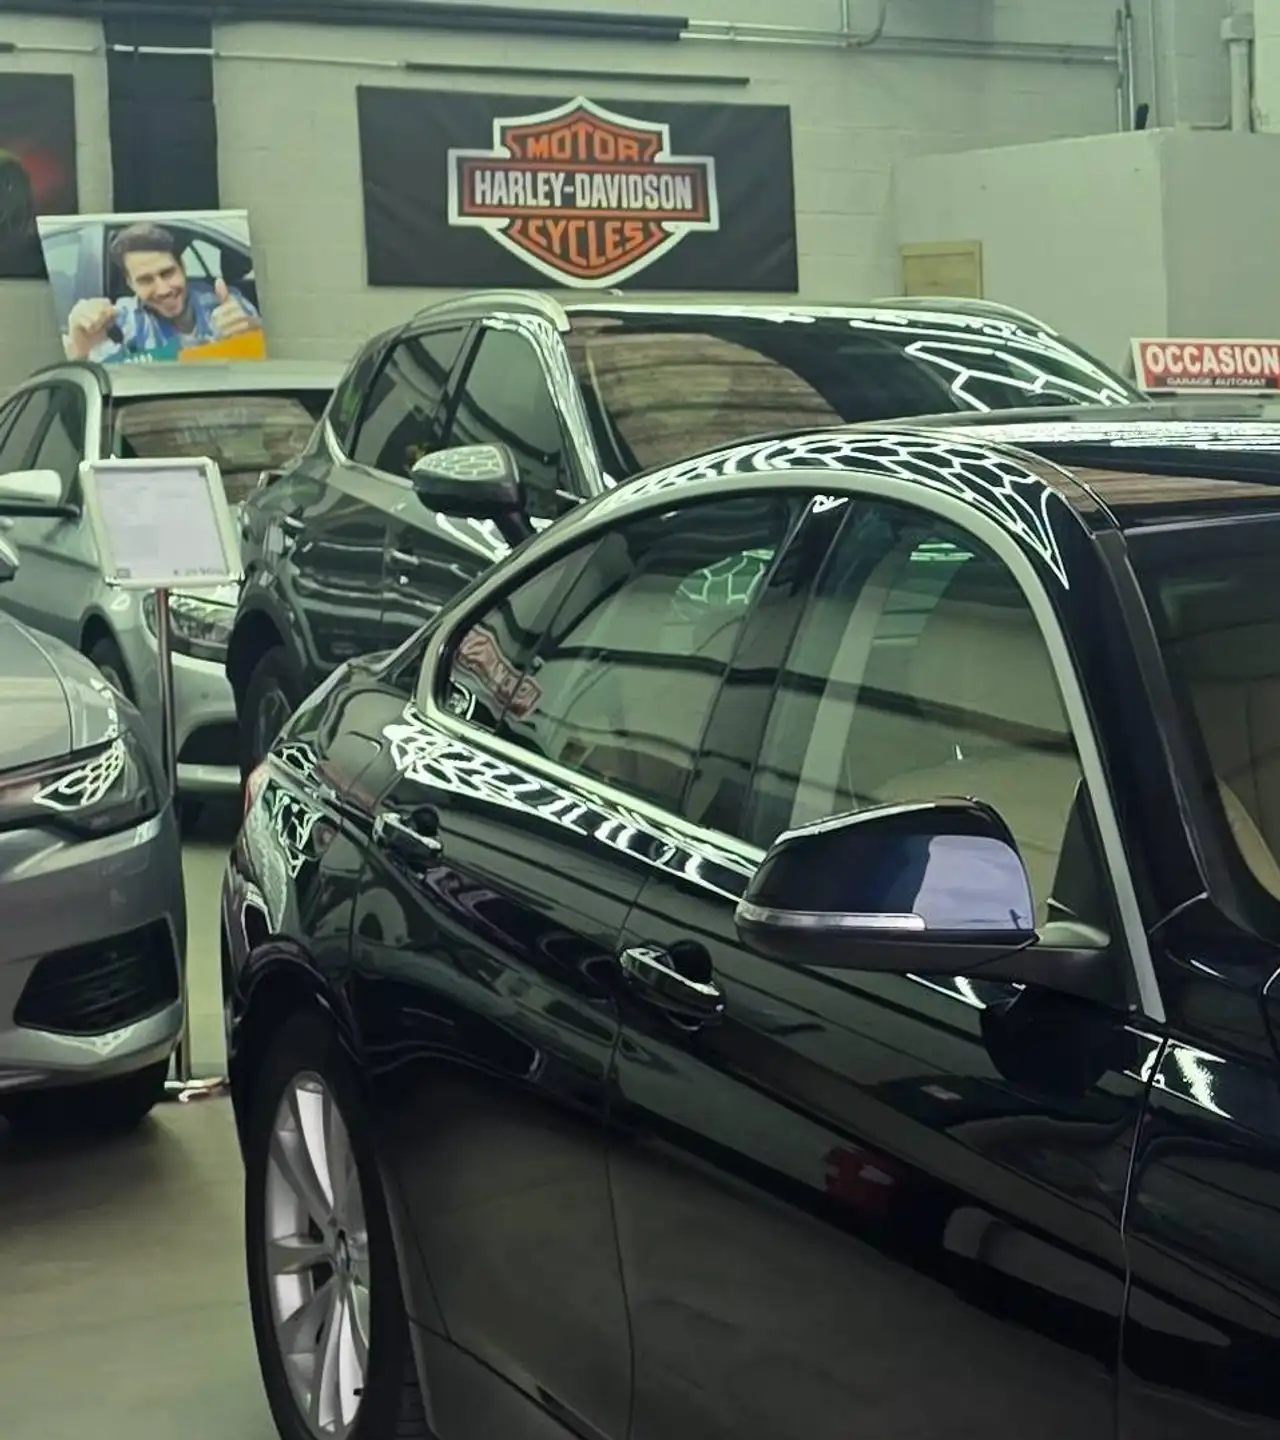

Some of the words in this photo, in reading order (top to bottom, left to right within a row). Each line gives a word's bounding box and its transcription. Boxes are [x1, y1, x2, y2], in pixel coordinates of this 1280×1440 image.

[526, 121, 637, 161] MOTOR
[474, 170, 692, 210] HARLEY-DAVIDSON
[528, 219, 643, 267] CYCLES
[1146, 344, 1280, 375] OCCASION
[1215, 378, 1267, 387] AUTOMAT
